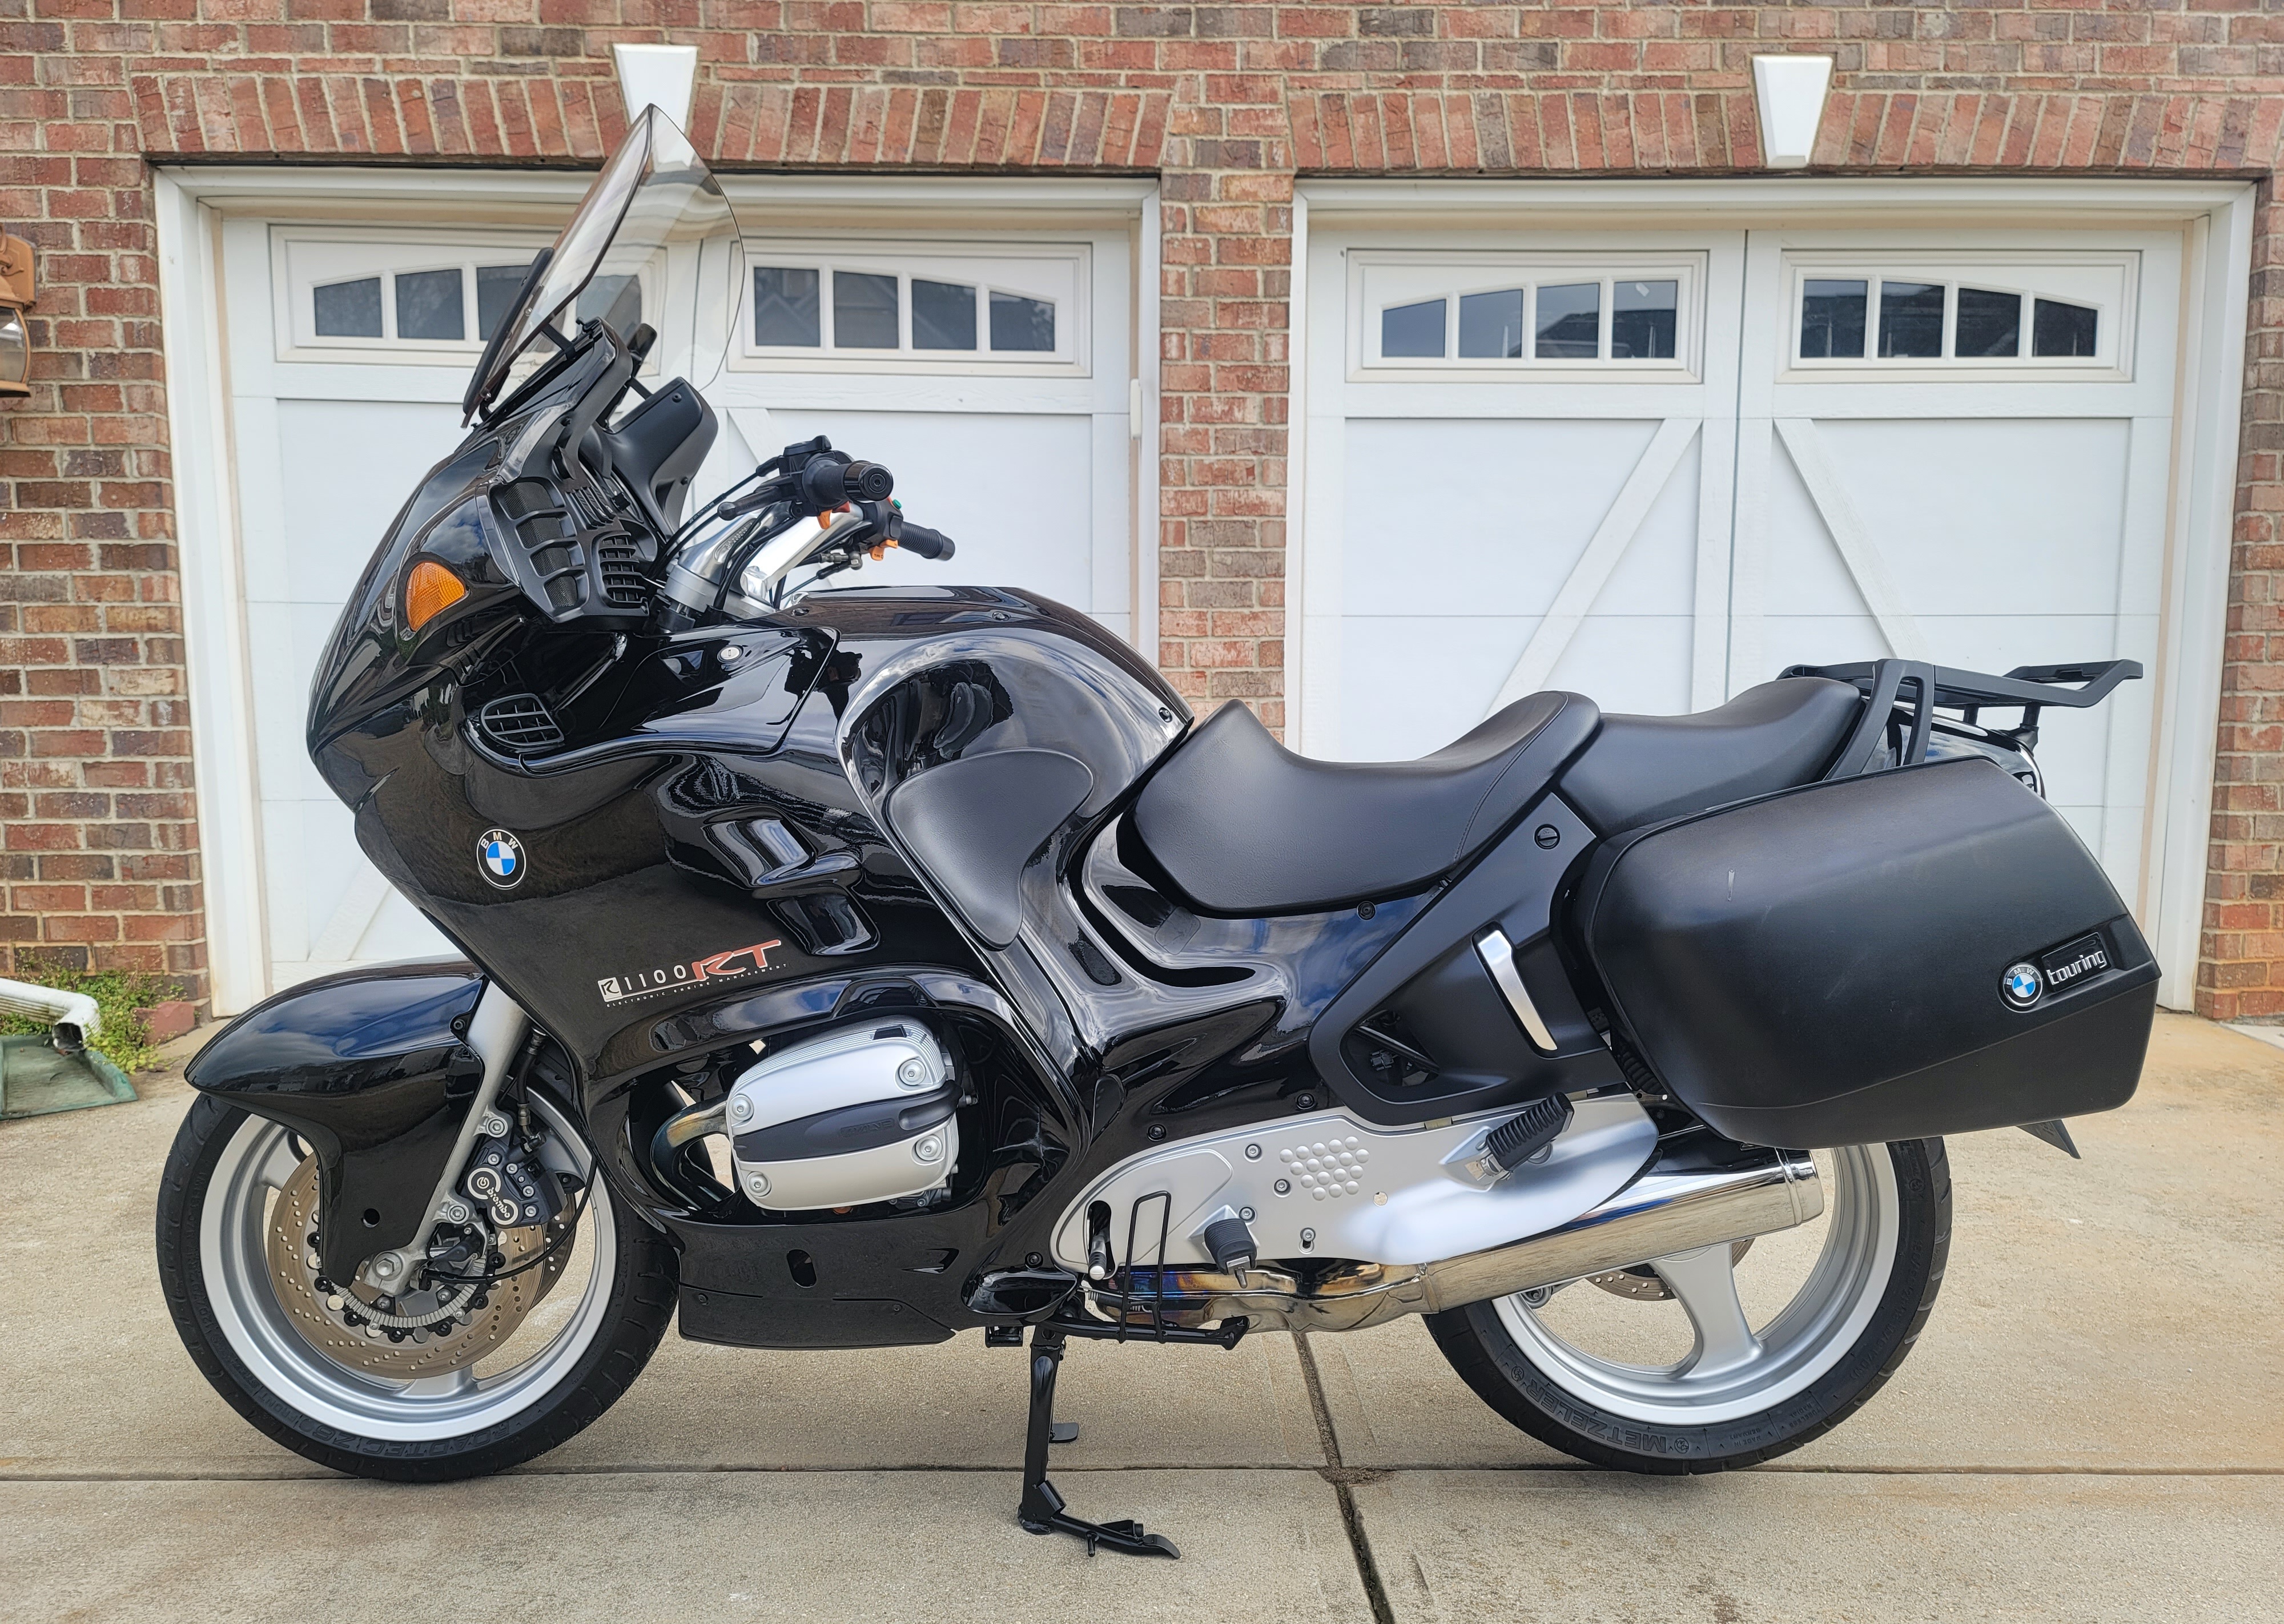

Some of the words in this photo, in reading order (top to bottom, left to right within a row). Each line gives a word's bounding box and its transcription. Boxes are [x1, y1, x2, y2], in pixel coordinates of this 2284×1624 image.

[480, 832, 518, 849] BMW
[2006, 968, 2034, 985] BMW
[2046, 950, 2108, 985] touring
[606, 992, 666, 1008] ELECTRONIC
[673, 981, 710, 993] ENGINE
[718, 964, 787, 982] MANAGEMENT
[486, 1187, 510, 1218] brembo
[1522, 1378, 1667, 1452] METZELER
[311, 1422, 359, 1451] Z6
[363, 1419, 512, 1457] ROADTEC
